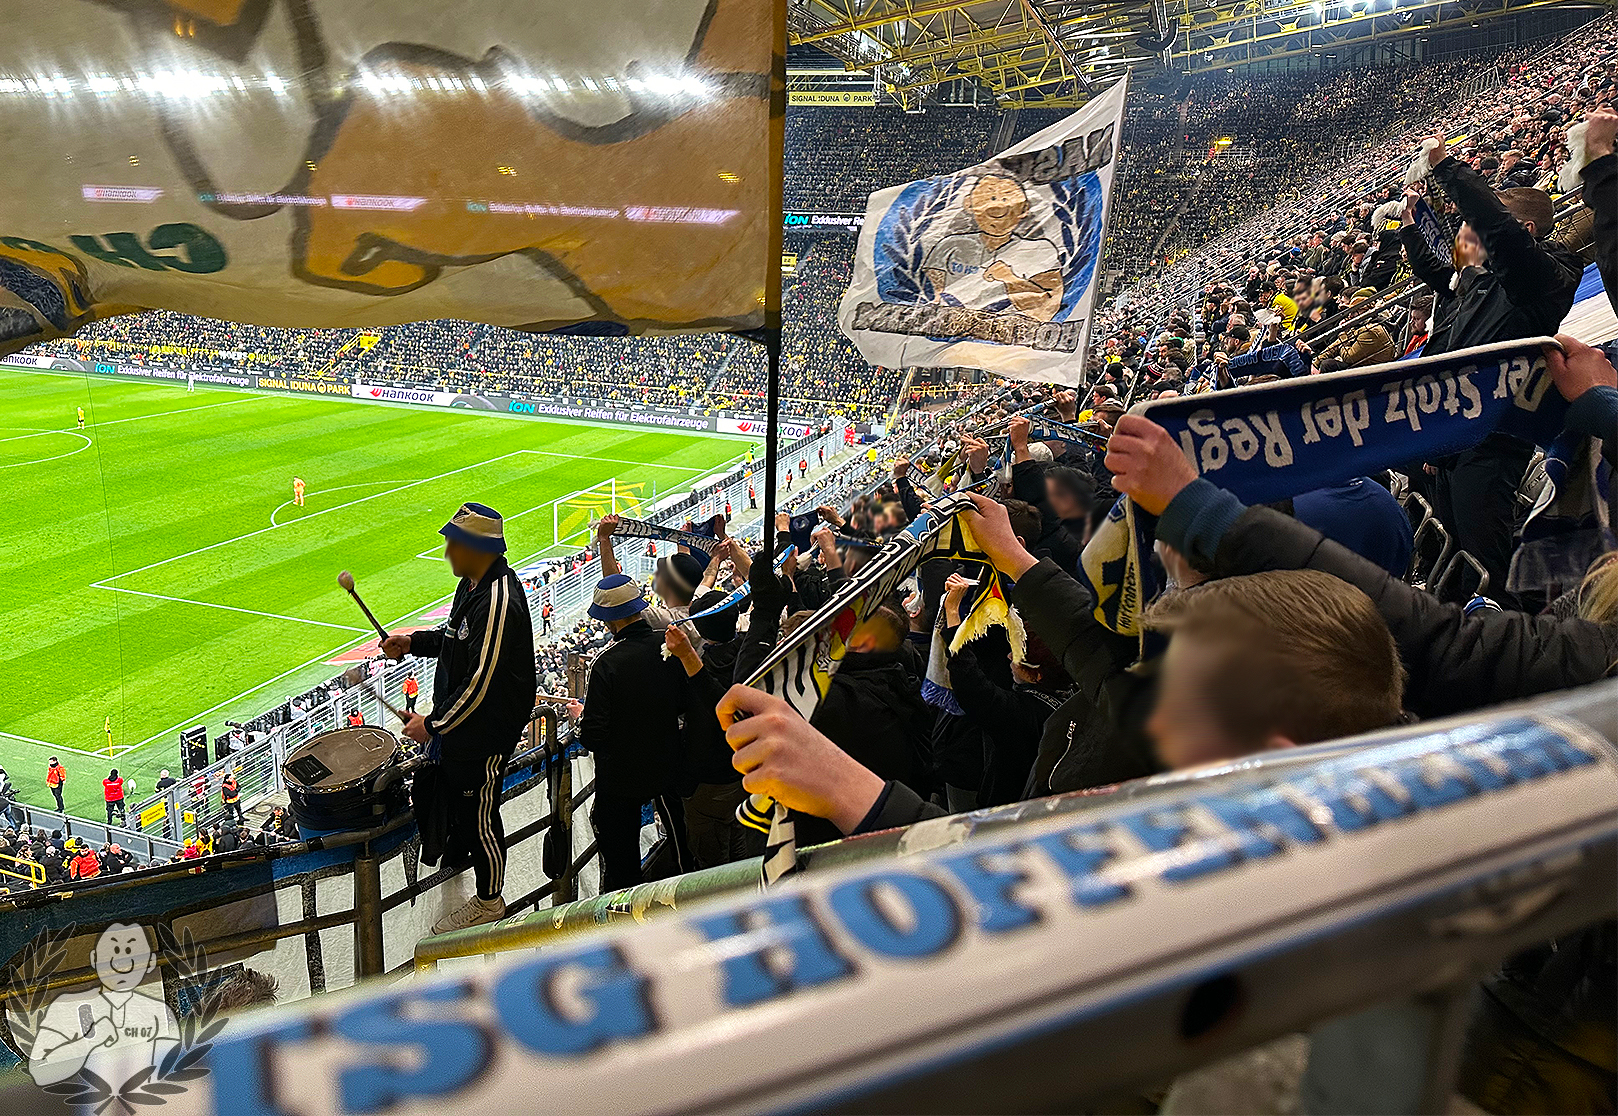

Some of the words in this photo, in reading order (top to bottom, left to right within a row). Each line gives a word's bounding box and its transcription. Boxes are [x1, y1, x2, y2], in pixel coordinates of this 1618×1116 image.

[258, 377, 290, 389] SIGNAL
[290, 381, 318, 393] IDUNA
[327, 383, 351, 395] PARK
[1381, 364, 1483, 432] Stolz
[1493, 355, 1553, 413] Der
[584, 408, 613, 421] Reifen
[614, 410, 629, 421] für
[630, 413, 709, 431] Elektrofahrzeuge
[1301, 389, 1370, 448] der
